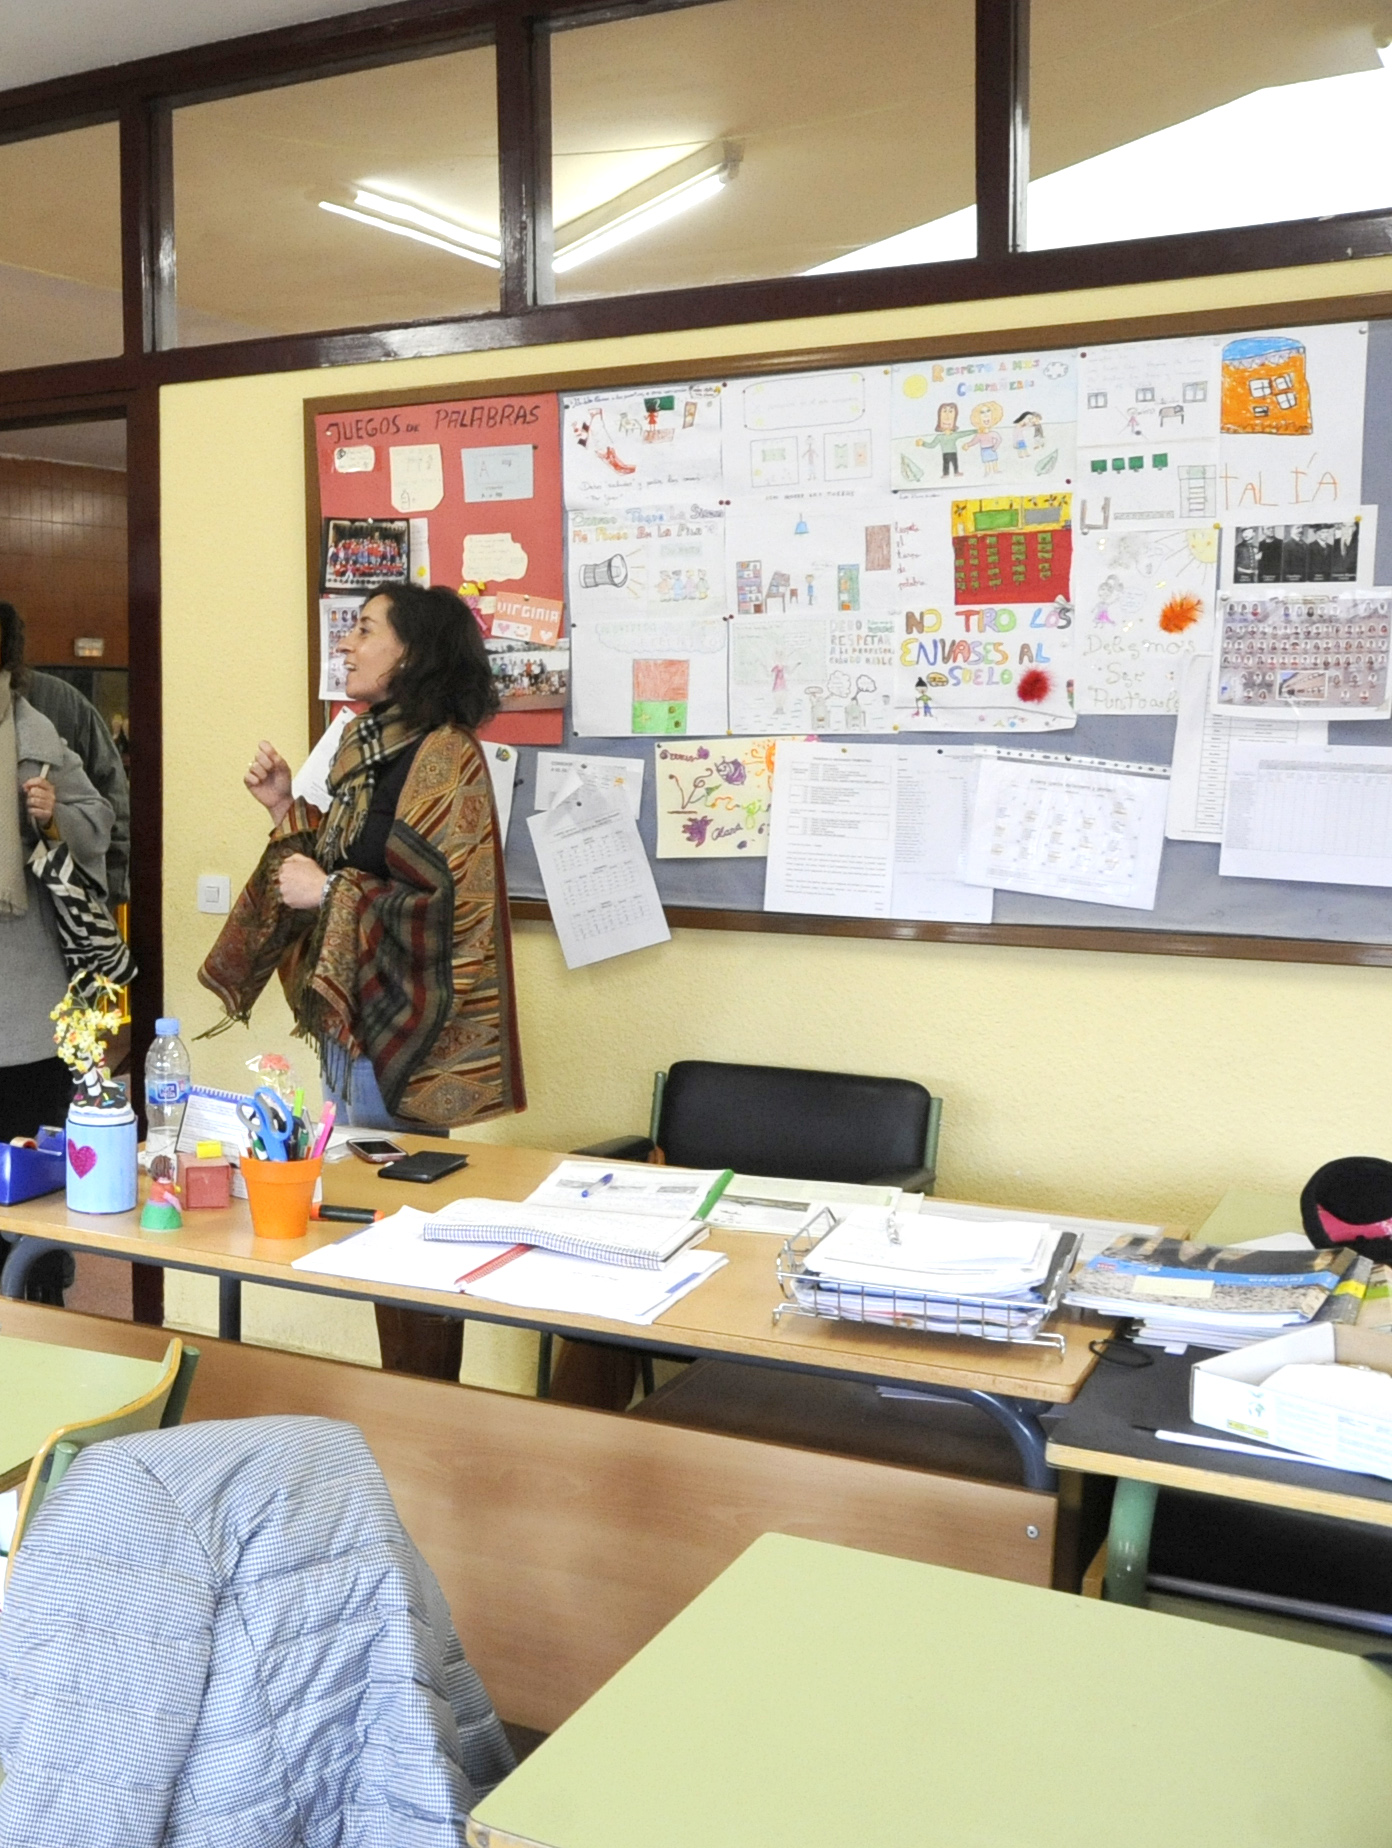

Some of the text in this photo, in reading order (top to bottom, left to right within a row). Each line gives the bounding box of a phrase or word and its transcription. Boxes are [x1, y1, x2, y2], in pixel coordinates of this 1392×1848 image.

[328, 414, 401, 443] JUEGOS
[435, 404, 541, 430] PALABRAS
[497, 600, 560, 623] VIRGINIA
[905, 608, 942, 634] NO
[955, 607, 1017, 633] TIRO
[1030, 607, 1072, 629] LOS
[899, 637, 1050, 667] ENVASES AL
[948, 665, 1013, 686] SUELO
